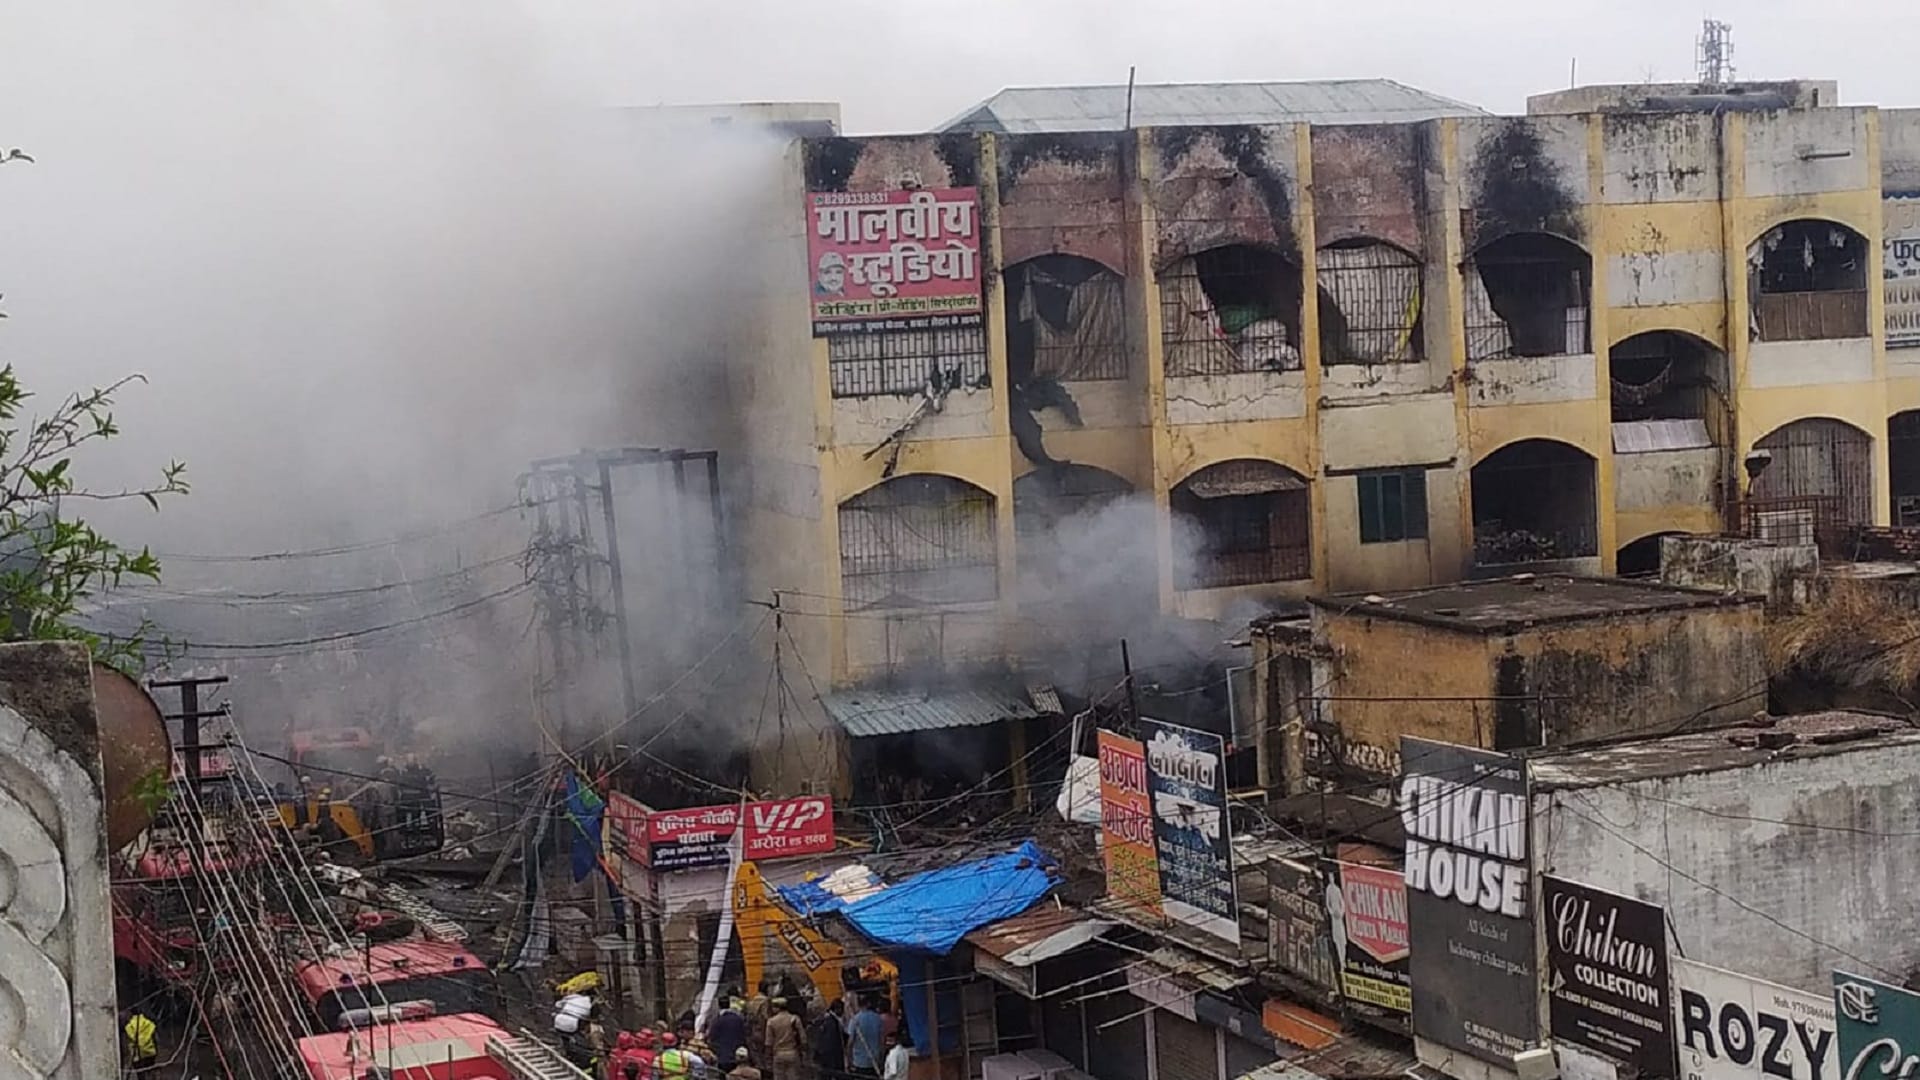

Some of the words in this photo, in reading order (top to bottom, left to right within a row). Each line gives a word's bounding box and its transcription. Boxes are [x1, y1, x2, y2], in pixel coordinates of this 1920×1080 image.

[815, 191, 975, 242] मालवीय
[847, 239, 977, 297] स्टूडियो
[656, 815, 696, 835] पुलिस
[752, 800, 825, 834] VIP
[1400, 774, 1526, 861] CHIKAN
[1346, 881, 1408, 925] CHIKAN
[1404, 838, 1528, 919] HOUSE
[783, 930, 821, 969] JCB
[1552, 892, 1657, 979] Chikan
[1574, 963, 1660, 1007] COLLECTION
[1680, 987, 1836, 1080] ROZY
